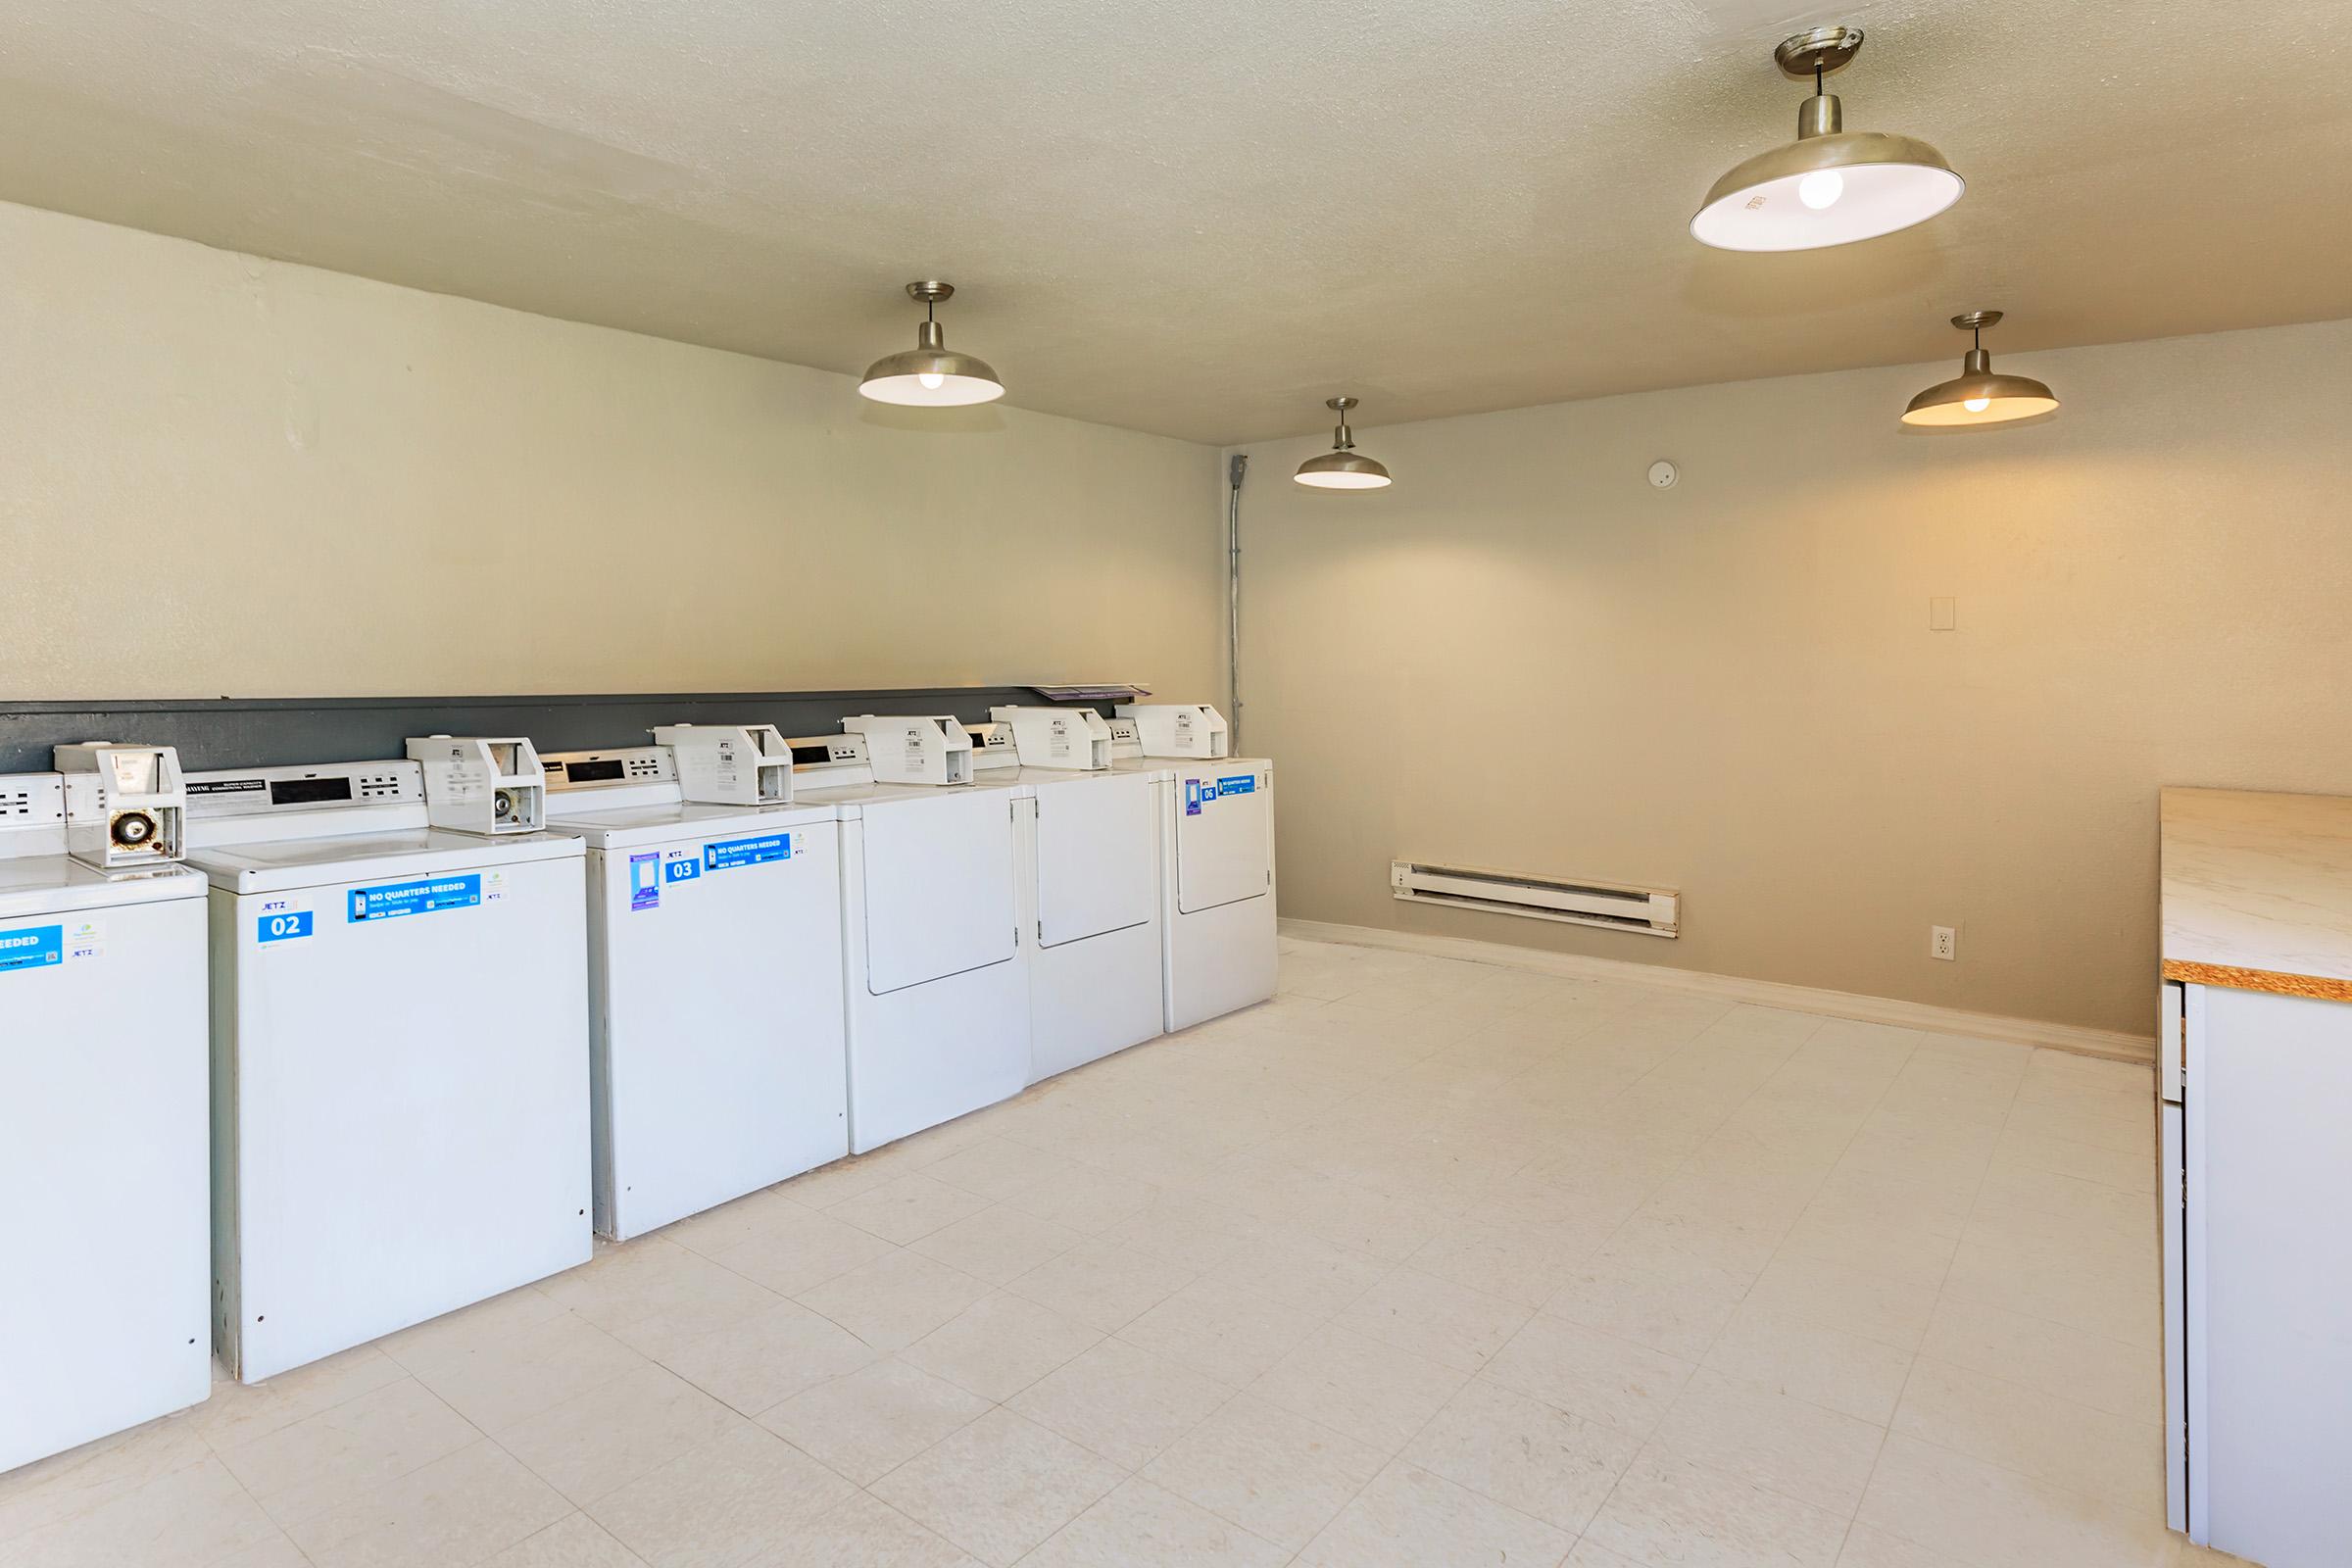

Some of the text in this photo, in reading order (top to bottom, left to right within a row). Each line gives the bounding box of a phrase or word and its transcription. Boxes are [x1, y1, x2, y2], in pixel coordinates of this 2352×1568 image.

[1204, 788, 1214, 800] 06
[673, 861, 693, 878] 03
[368, 893, 383, 902] NO
[384, 886, 431, 902] QUARTERS
[431, 882, 466, 893] NEEDED
[262, 901, 286, 911] JETZ
[270, 915, 301, 936] 02
[0, 936, 39, 949] EEDED
